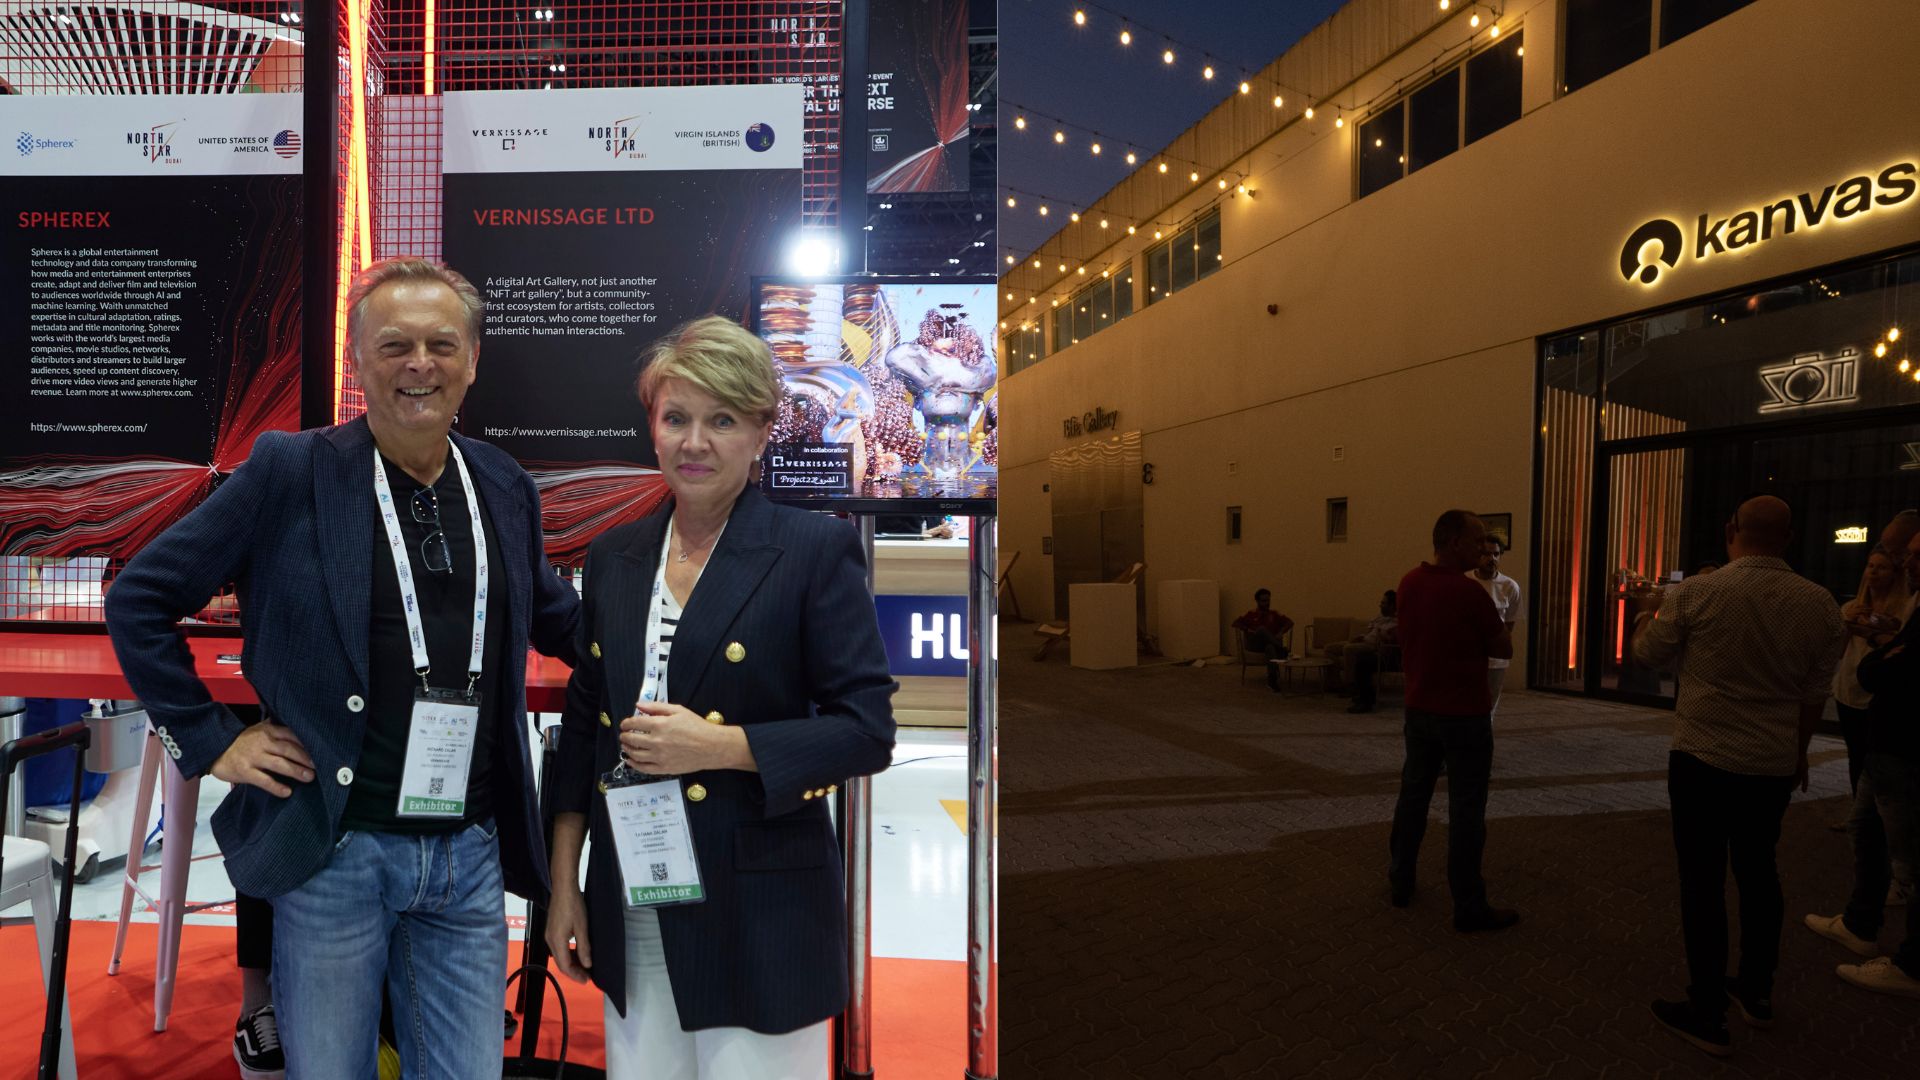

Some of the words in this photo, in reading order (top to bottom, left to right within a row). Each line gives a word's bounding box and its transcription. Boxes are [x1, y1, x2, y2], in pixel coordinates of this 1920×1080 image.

[804, 101, 823, 112] AL
[589, 127, 627, 139] NORTH
[675, 131, 704, 139] VIRGIN
[705, 130, 740, 138] ISLANDS
[127, 132, 163, 144] NORTH
[198, 137, 228, 145] UNITED
[606, 139, 635, 152] STAR
[702, 139, 740, 148] (BRITISH)
[143, 145, 171, 157] STAR
[1696, 162, 1918, 259] kanvas
[18, 211, 111, 228] SPHEREX
[474, 208, 608, 226] VERNISSAGE
[616, 207, 654, 225] LTD
[32, 248, 62, 257] Spherex
[64, 248, 70, 256] is
[79, 248, 102, 257] global
[104, 248, 158, 256] entertainment
[32, 259, 74, 268] technology
[148, 259, 197, 268] transforming
[148, 270, 191, 278] enterprises
[59, 281, 80, 289] adapt
[127, 280, 141, 288] film
[160, 280, 196, 288] television
[496, 277, 524, 288] digital
[526, 277, 541, 286] Art
[600, 277, 617, 287] just
[620, 276, 657, 285] another
[42, 291, 79, 299] audiences
[81, 291, 122, 299] worldwide
[124, 292, 154, 300] through
[166, 291, 181, 299] and
[513, 290, 526, 298] art
[567, 289, 582, 298] but
[594, 289, 650, 299] community-
[32, 302, 63, 310] machine
[125, 302, 168, 310] unmatched
[486, 302, 504, 310] first
[507, 302, 556, 312] ecosystem
[559, 301, 572, 310] for
[609, 301, 654, 310] collectors
[31, 313, 66, 321] expertise
[486, 314, 503, 322] and
[549, 314, 569, 322] who
[600, 314, 641, 324] together
[643, 314, 657, 322] for
[149, 324, 180, 332] Spherex
[486, 326, 530, 335] authentic
[533, 326, 564, 335] human
[31, 334, 54, 342] works
[56, 334, 73, 342] with
[75, 334, 88, 342] the
[120, 334, 145, 343] largest
[147, 334, 170, 342] media
[143, 356, 162, 364] build
[164, 356, 186, 365] larger
[73, 367, 96, 375] speed
[137, 379, 170, 387] generate
[173, 378, 197, 387] higher
[66, 388, 87, 396] Learn
[1083, 406, 1118, 433] Gallery
[31, 422, 148, 433] https://www.spherex.com/
[485, 427, 636, 438] https://www.vernissage.network
[409, 800, 457, 811] Exhibitor
[637, 887, 692, 901] Exhibitor
